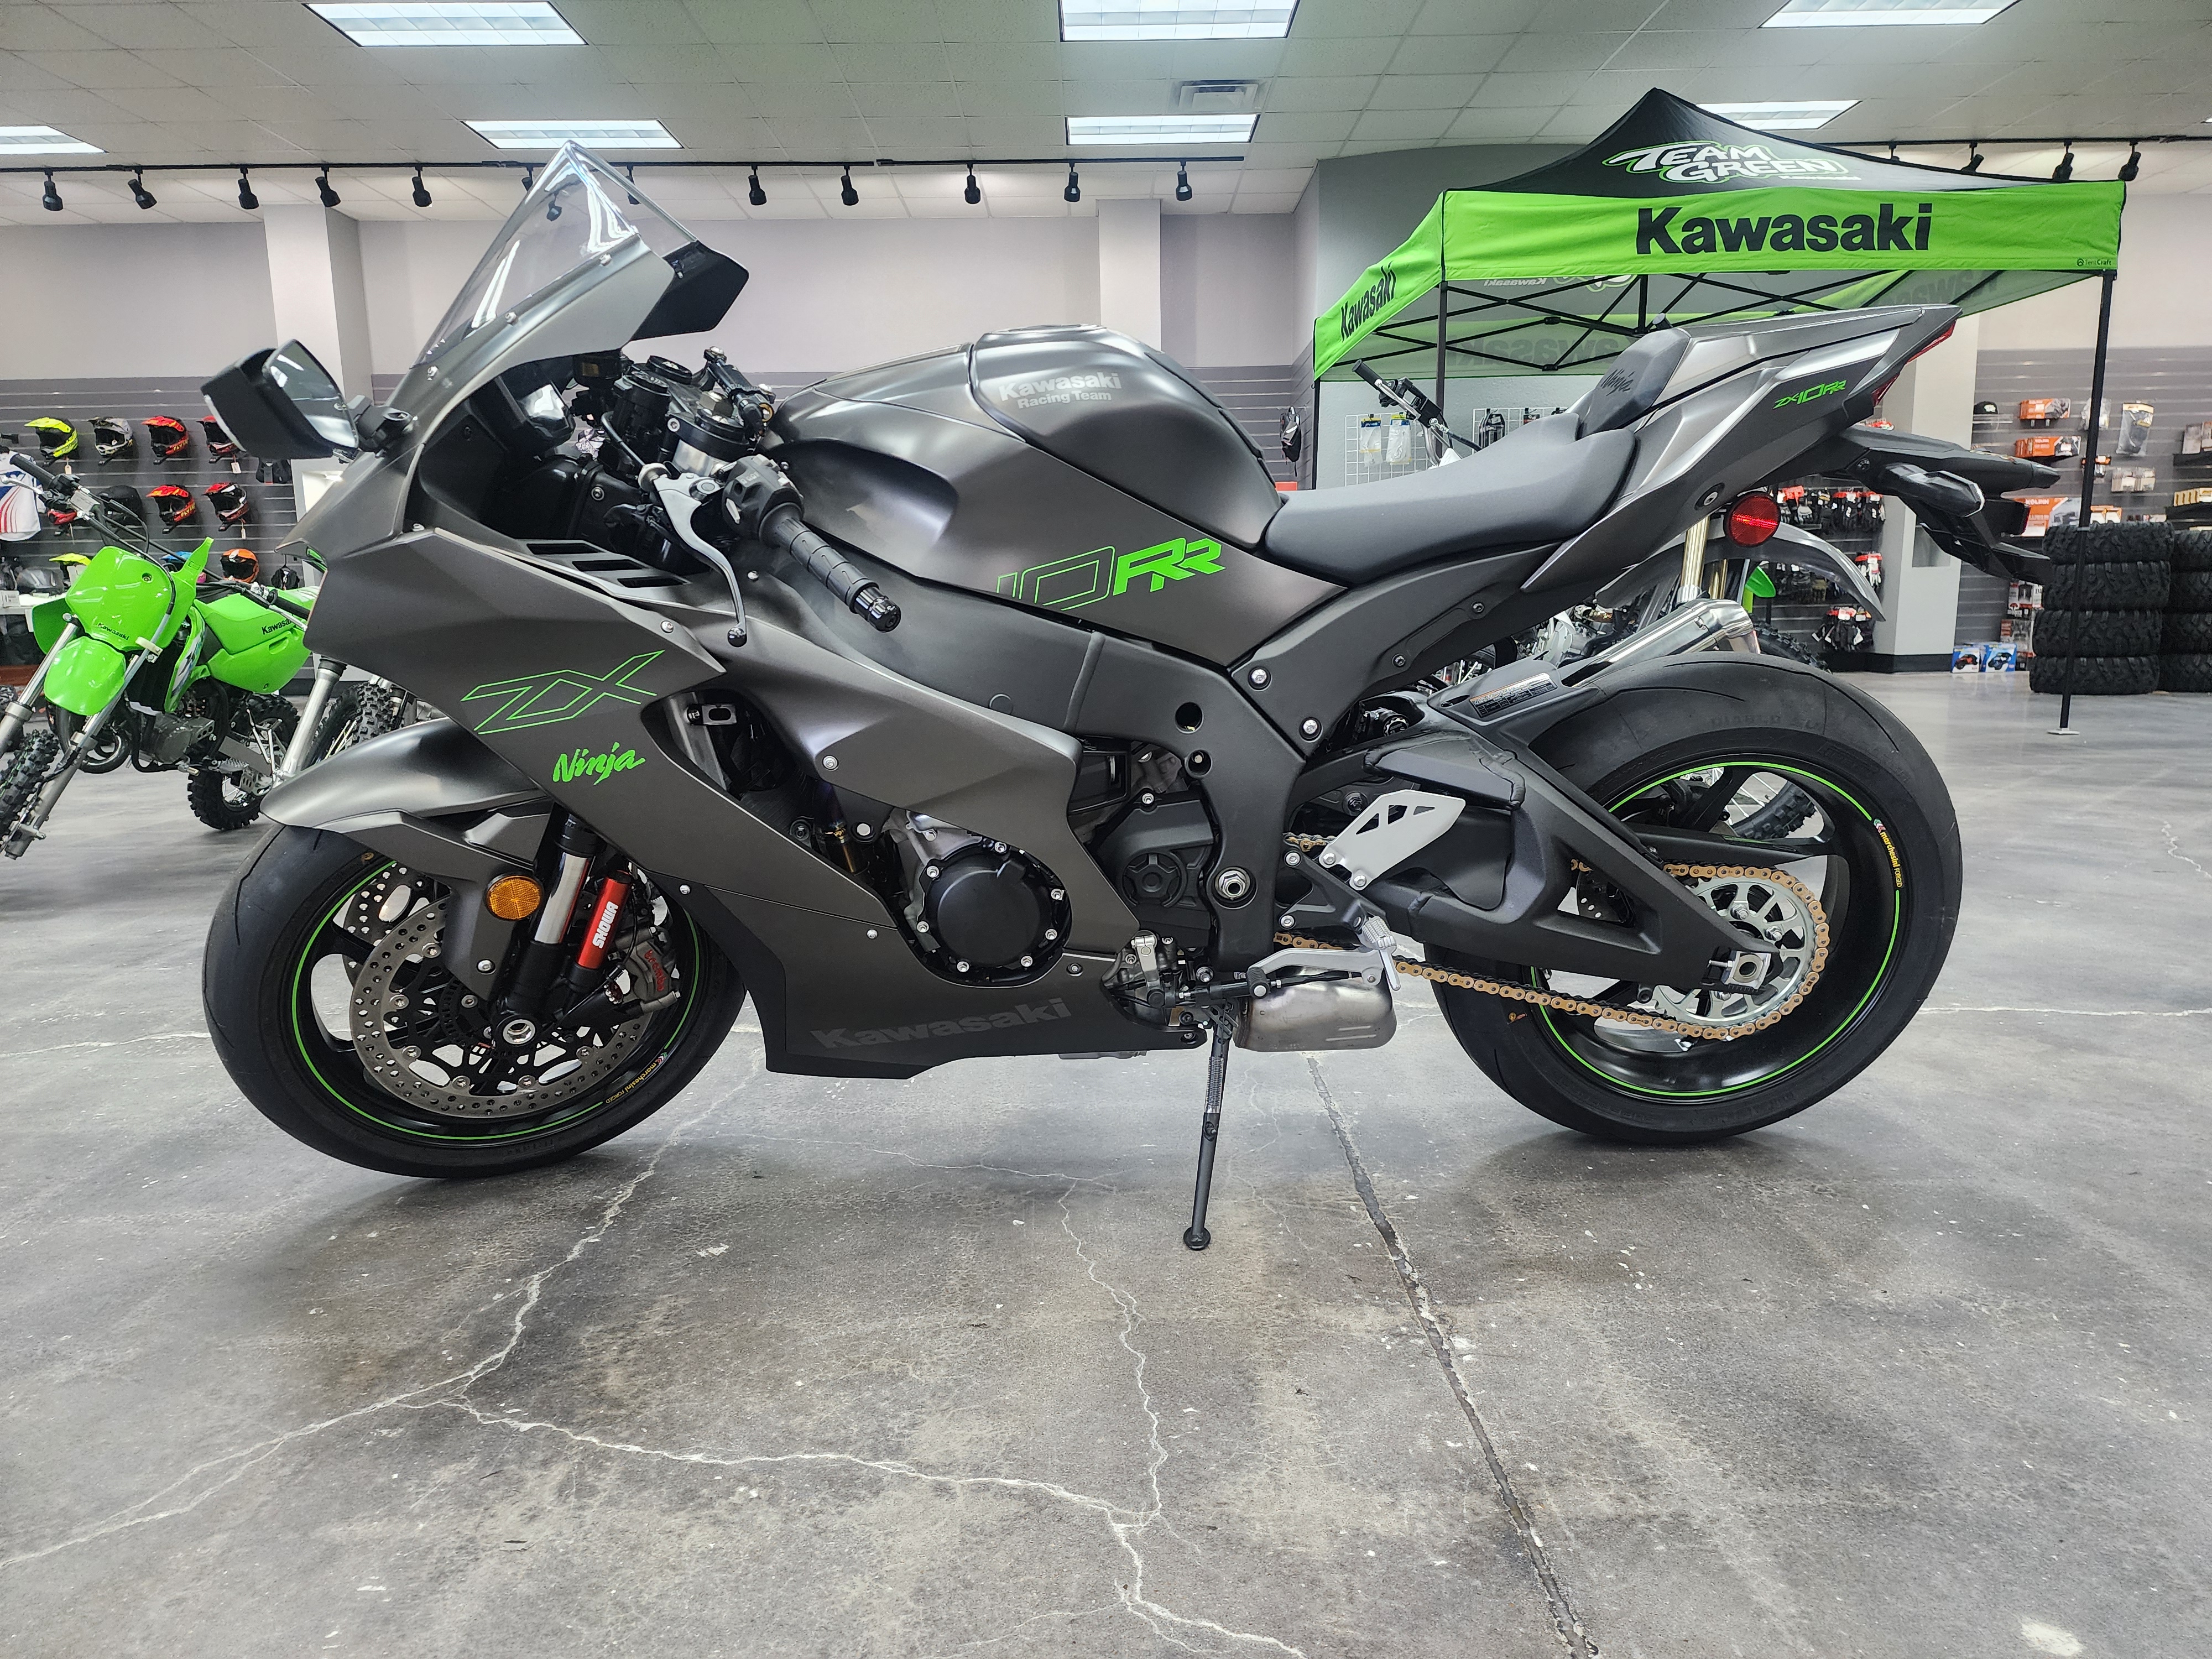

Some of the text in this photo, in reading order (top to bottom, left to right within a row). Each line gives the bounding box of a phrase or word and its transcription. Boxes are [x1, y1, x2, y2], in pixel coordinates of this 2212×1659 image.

[1609, 143, 1770, 171] TEAM
[1666, 158, 1838, 182] GREEN
[1636, 203, 1933, 254] Kawasaki
[1340, 260, 1396, 343] Kawasaki
[998, 372, 1122, 401] Kawasaki
[1017, 390, 1112, 409] Racing Team
[1600, 368, 1635, 396] Ninja
[262, 619, 292, 635] Kawasa
[460, 649, 665, 734] ZX
[552, 742, 646, 785] Ninja
[1880, 831, 1901, 868] marchesini
[592, 901, 619, 949] SHOWA
[644, 949, 667, 992] brembo
[810, 997, 1072, 1048] Kawasaki
[606, 1062, 657, 1104] marchesini FORGED
